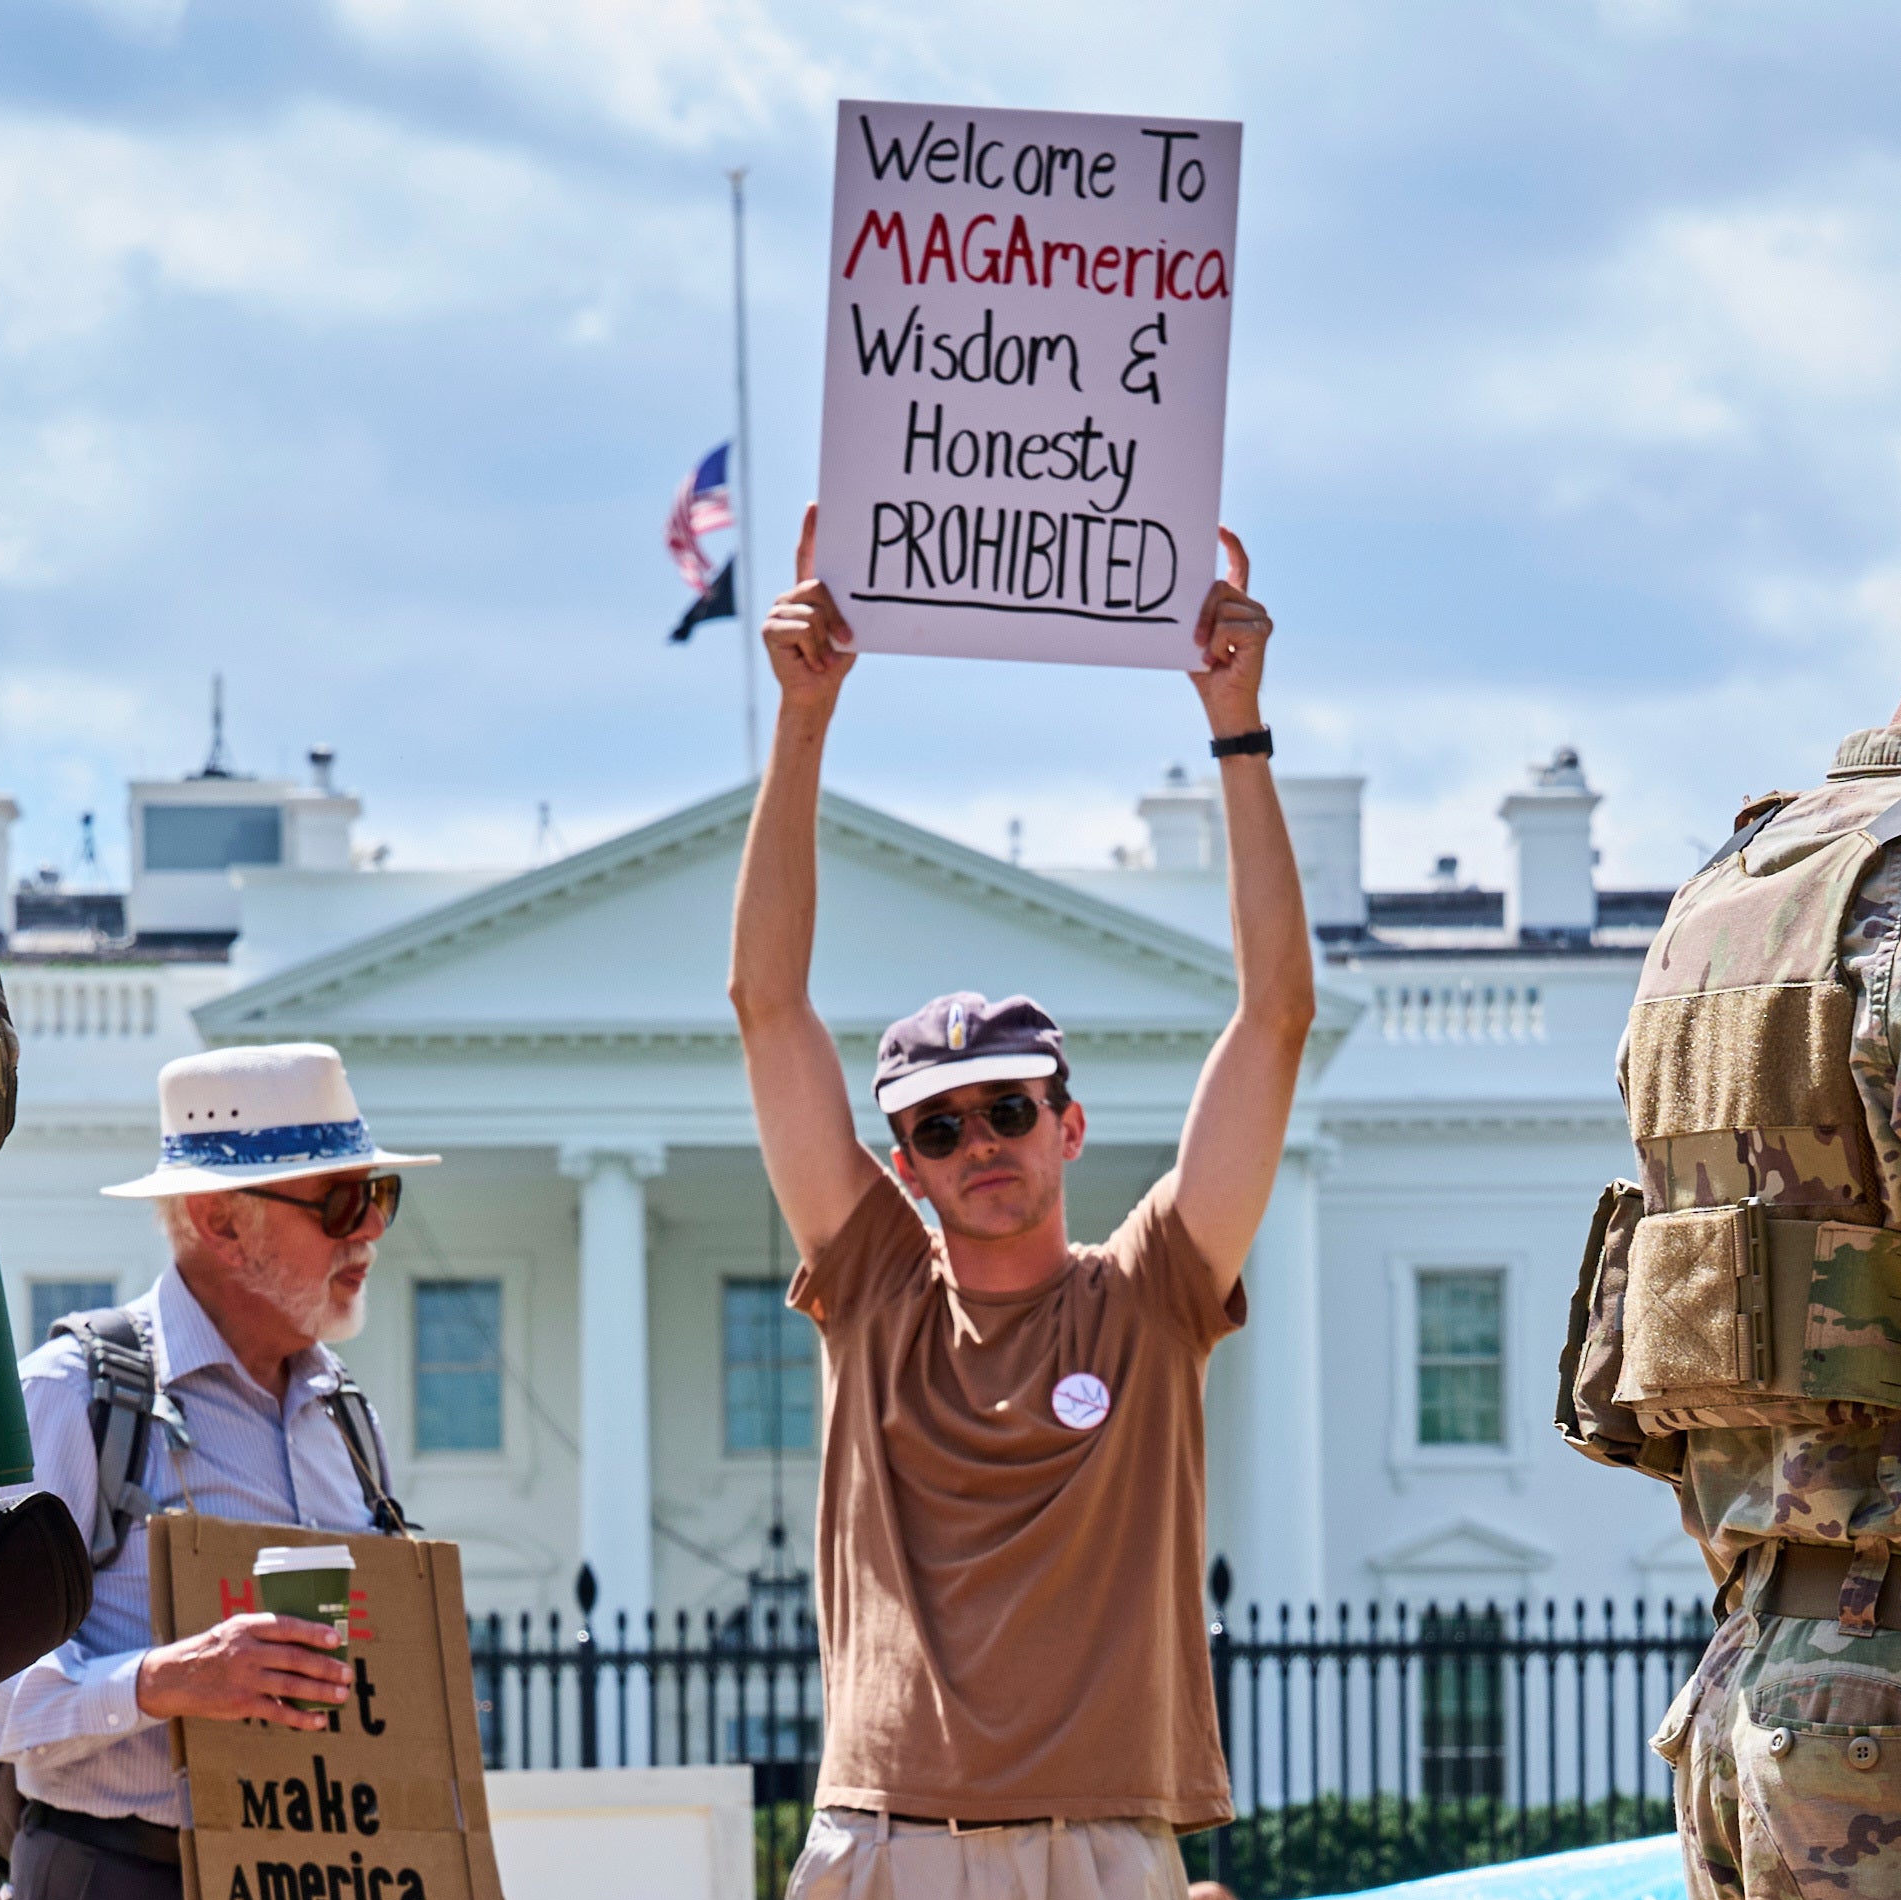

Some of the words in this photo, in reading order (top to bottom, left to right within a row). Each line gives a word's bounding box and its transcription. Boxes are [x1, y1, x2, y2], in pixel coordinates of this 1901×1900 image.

[859, 114, 1116, 199] Welcome
[1141, 128, 1206, 203] To
[842, 209, 1230, 300] MAGAmerica
[851, 303, 1084, 392] Wisdom
[1120, 312, 1168, 404] &
[903, 400, 1137, 513] Honesty
[868, 500, 1178, 613] PROHIBITED
